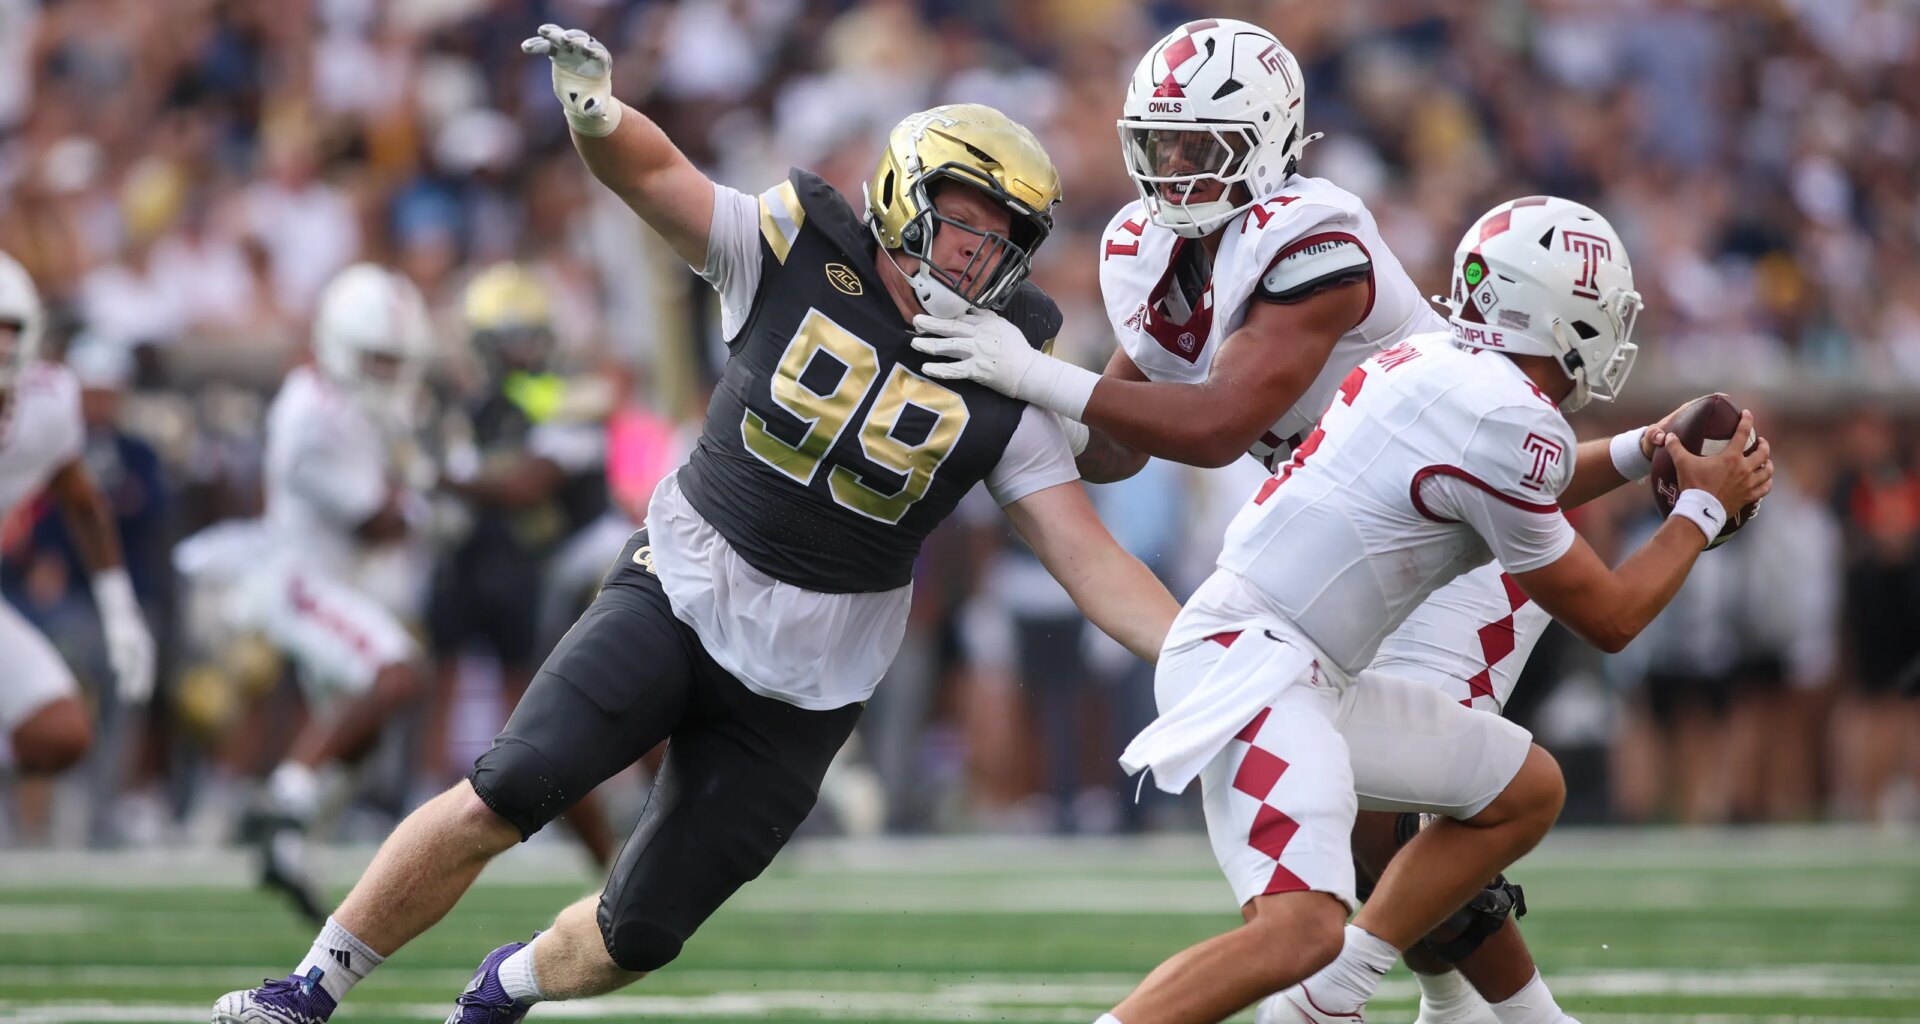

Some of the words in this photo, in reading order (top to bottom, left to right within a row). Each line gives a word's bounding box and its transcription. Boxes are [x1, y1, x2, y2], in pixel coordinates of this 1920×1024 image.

[1148, 102, 1182, 113] OWLS
[1241, 196, 1302, 234] 71
[828, 270, 856, 291] ACC
[1562, 231, 1612, 300] T
[1482, 292, 1491, 304] 6
[740, 307, 970, 525] 99
[1520, 432, 1562, 491] T
